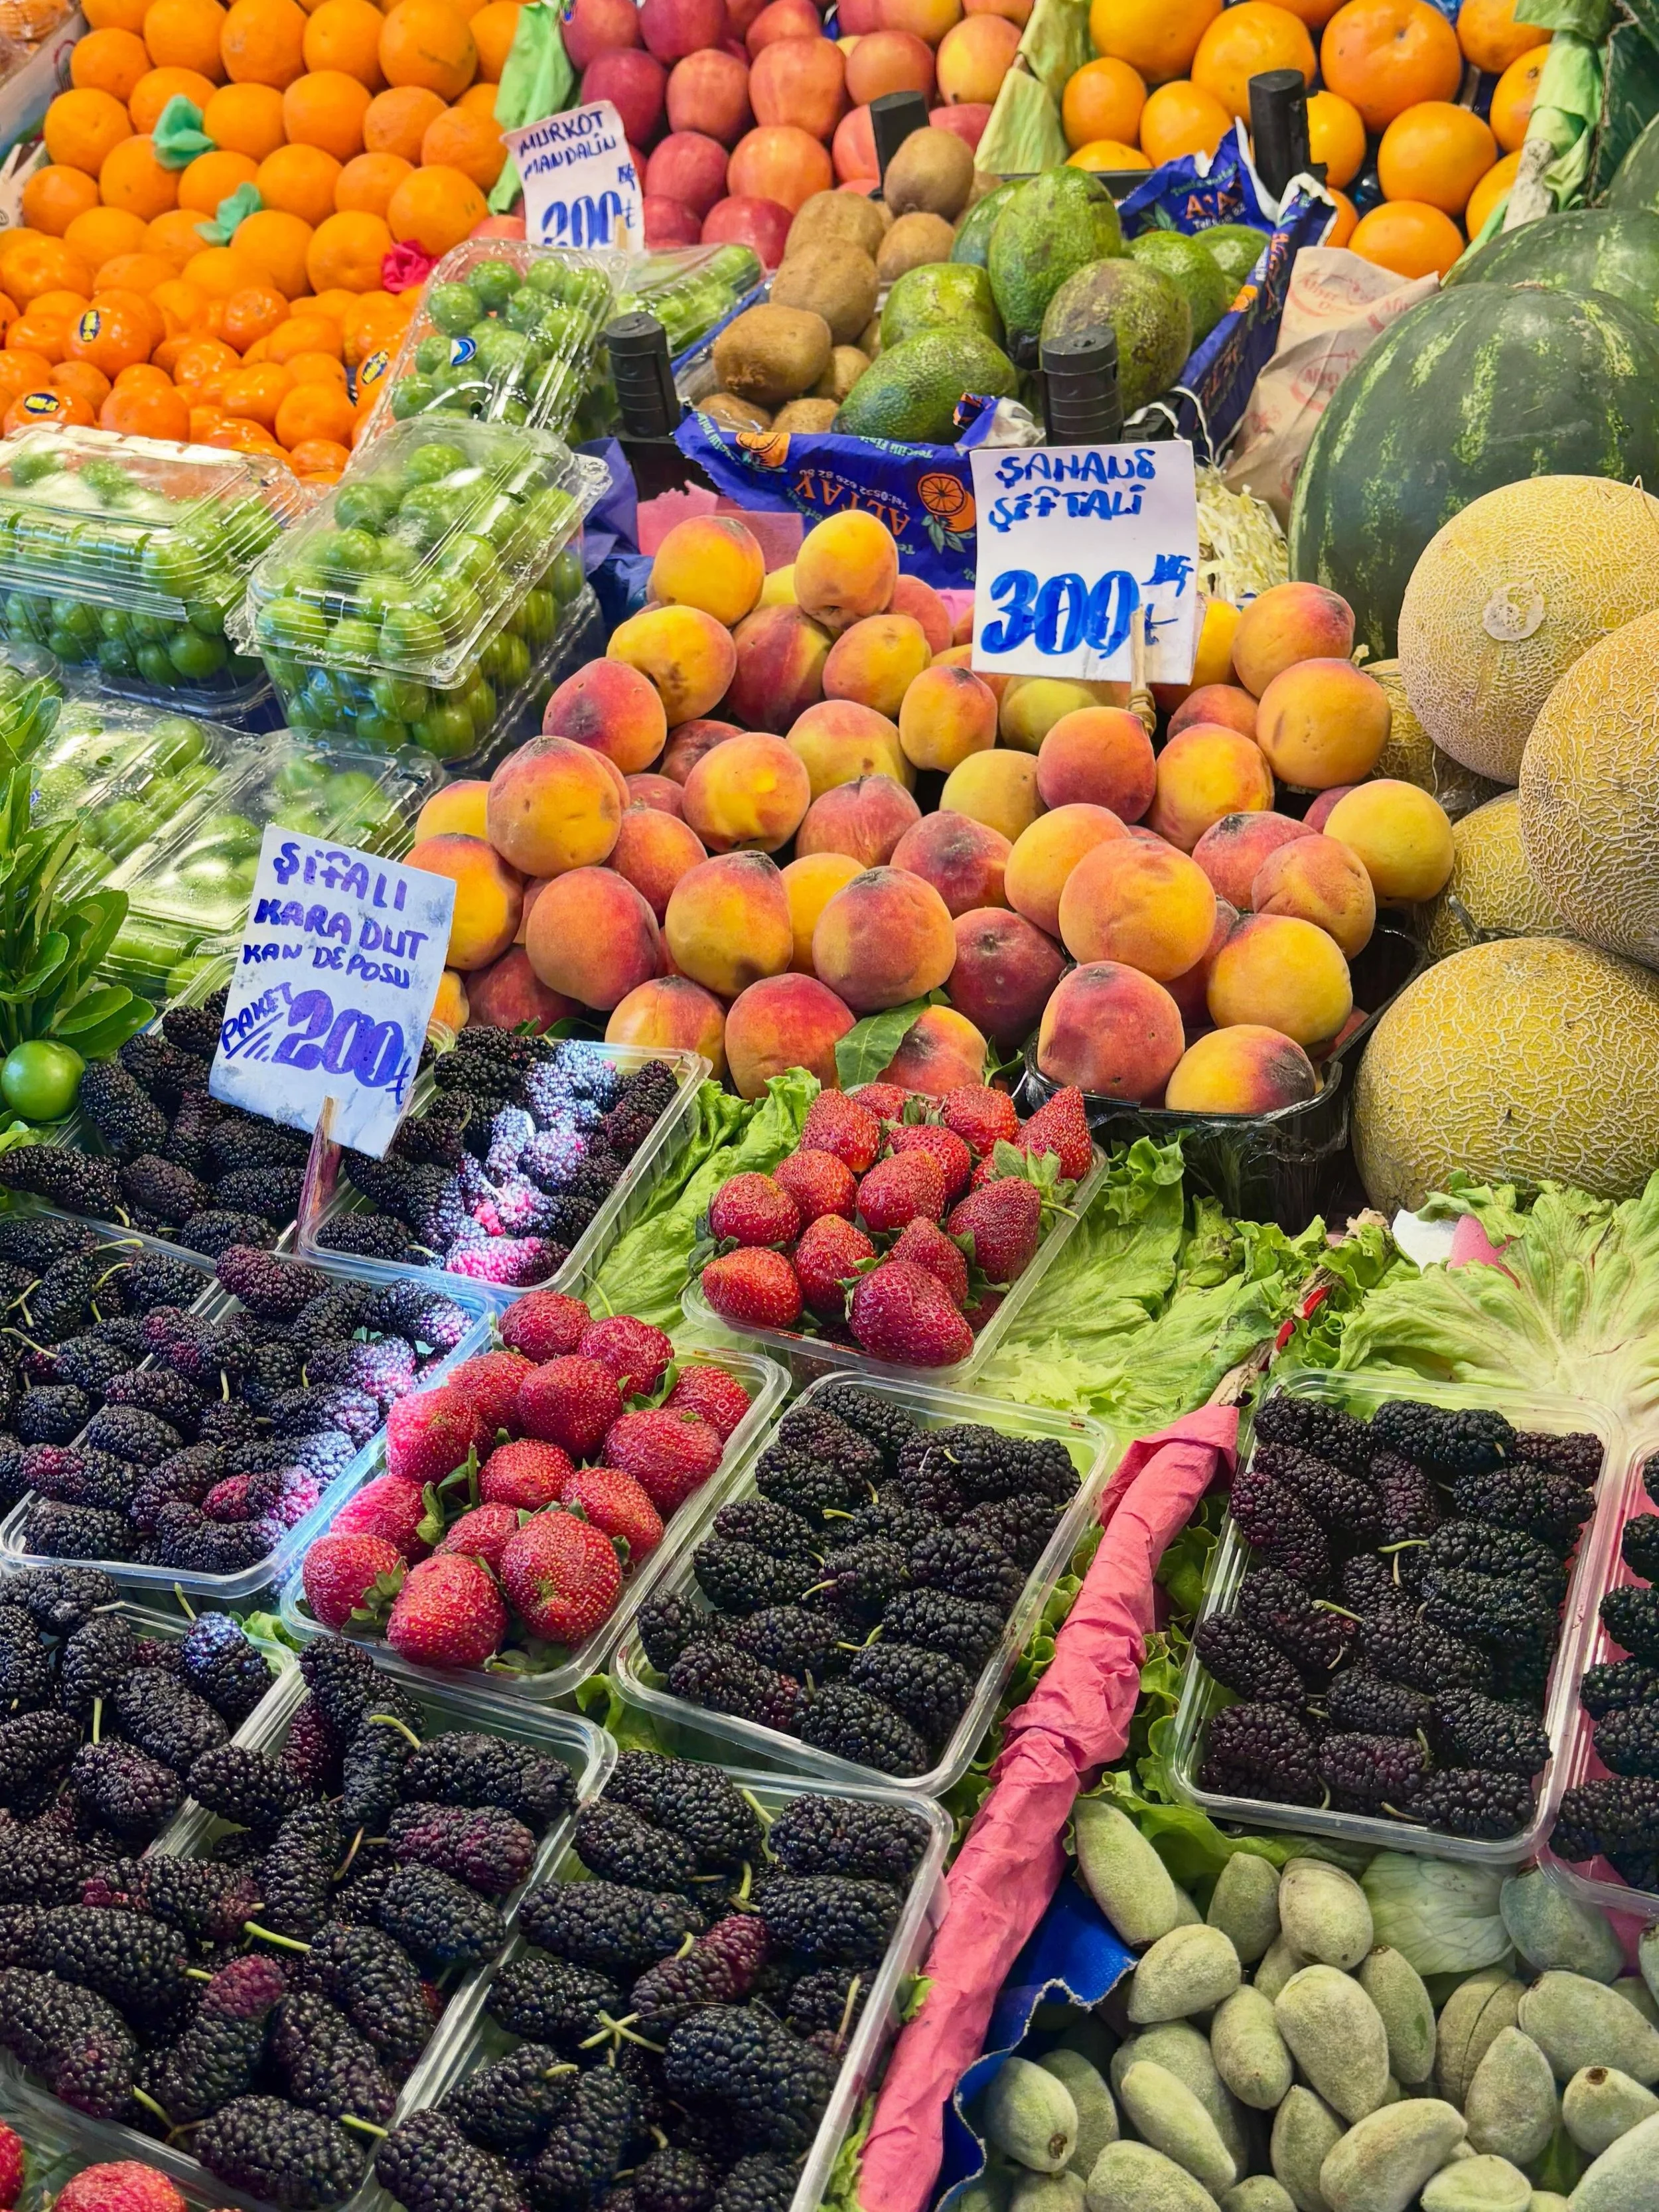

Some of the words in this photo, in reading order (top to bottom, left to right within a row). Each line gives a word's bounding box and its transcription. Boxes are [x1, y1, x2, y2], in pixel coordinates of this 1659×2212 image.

[520, 110, 603, 158] MURKOT
[524, 133, 617, 181] MANDALİN
[980, 569, 1141, 659] 300
[243, 943, 303, 965] KAN
[221, 982, 295, 1051] PAKET
